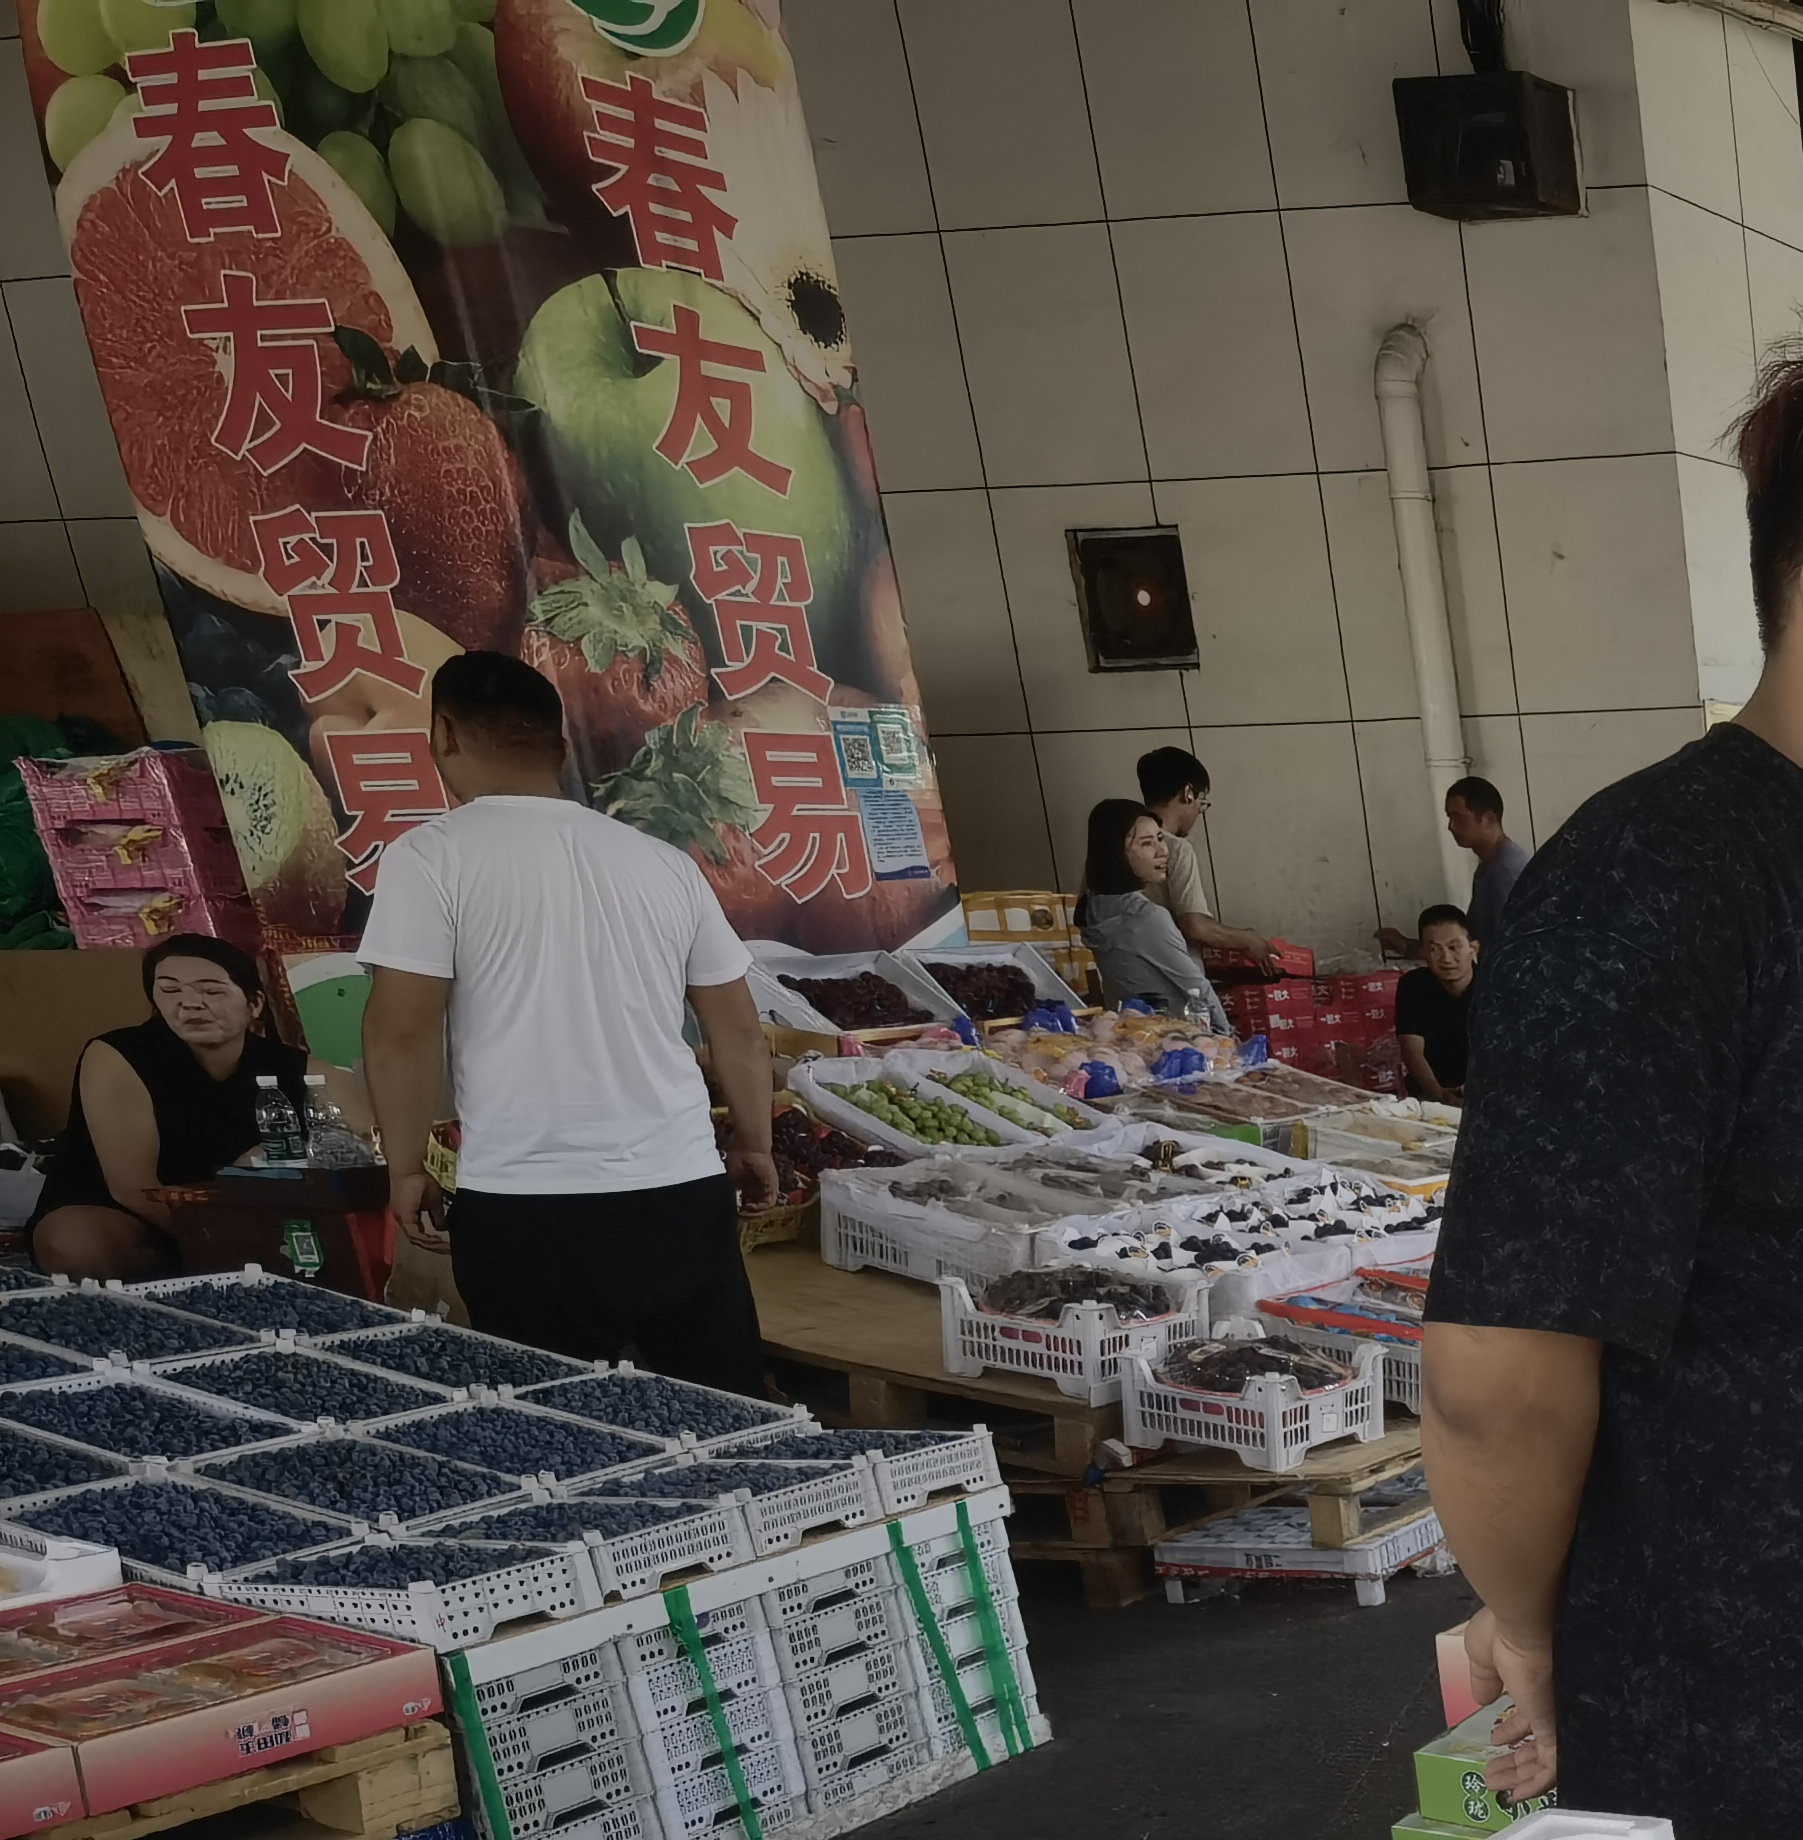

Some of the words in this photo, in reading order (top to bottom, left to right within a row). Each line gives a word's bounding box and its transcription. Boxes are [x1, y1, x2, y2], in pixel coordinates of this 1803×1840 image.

[126, 28, 453, 895] 春友贸易
[581, 73, 873, 905] 春友贸易
[1462, 1772, 1490, 1821] 玲珑
